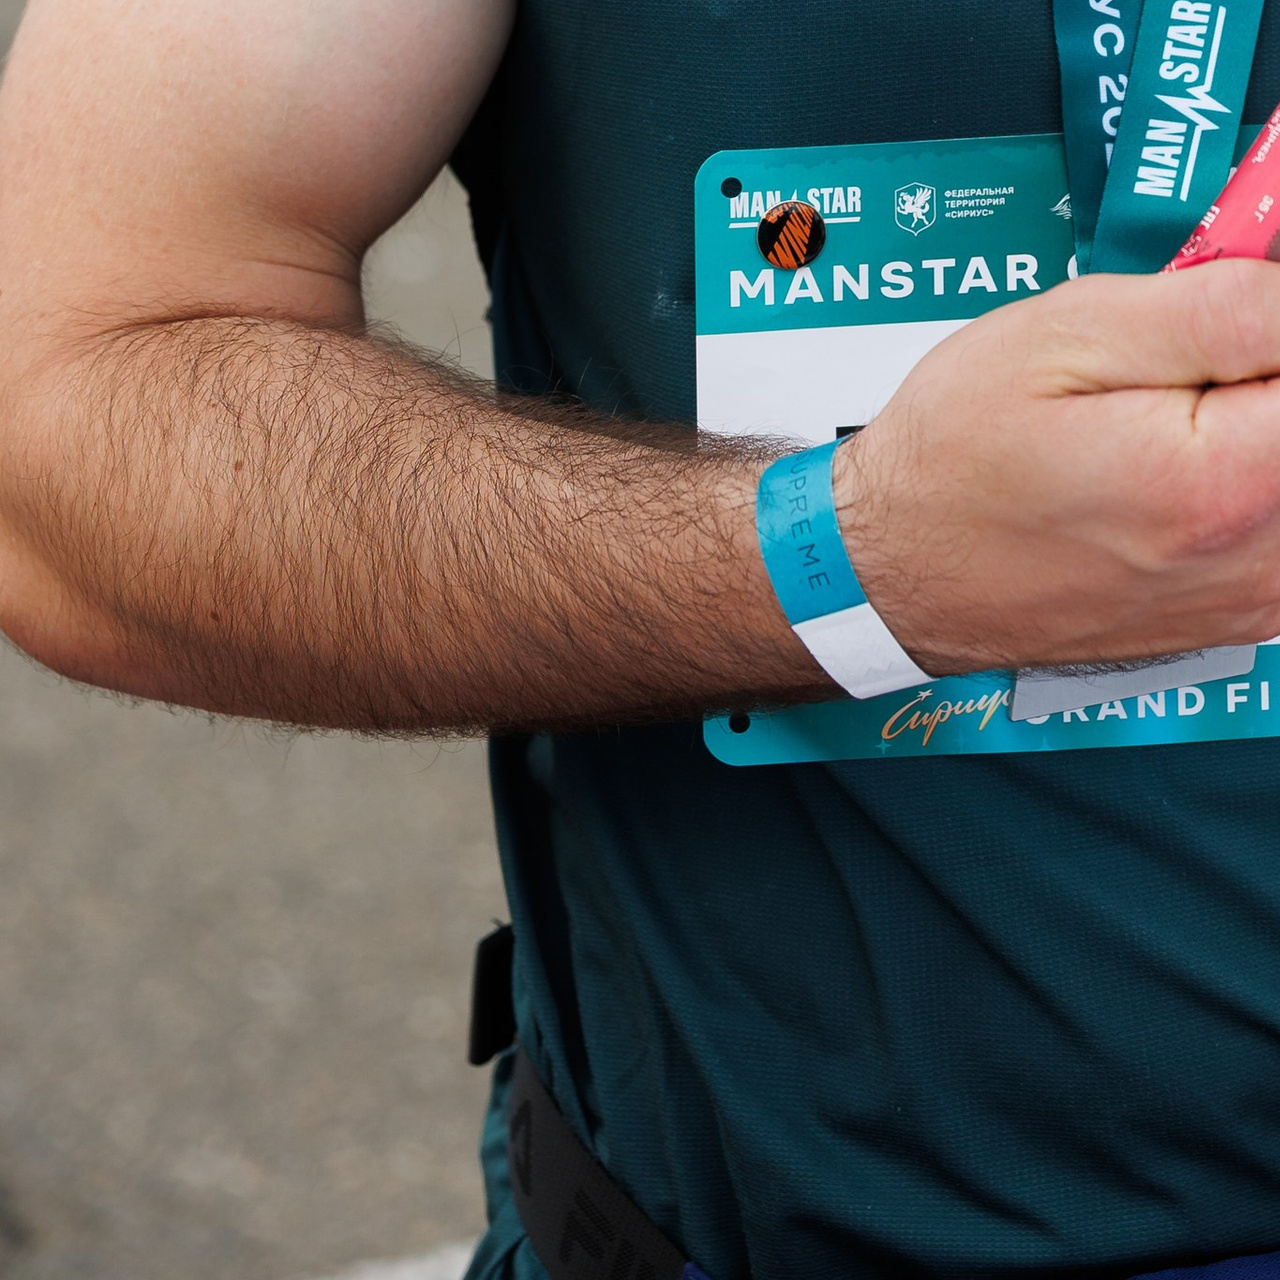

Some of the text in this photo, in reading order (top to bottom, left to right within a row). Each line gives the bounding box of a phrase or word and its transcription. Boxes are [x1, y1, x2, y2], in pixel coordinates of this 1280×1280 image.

[1133, 118, 1188, 198] MAN
[807, 186, 861, 213] STAR
[945, 187, 1014, 198] ФЕДЕРАЛЬНАЯ
[945, 198, 1005, 208] ТЕРРИТОРИЯ
[945, 209, 994, 218] «СИРИУС»
[730, 254, 1042, 307] MANSTAR
[1025, 686, 1206, 724] RAND
